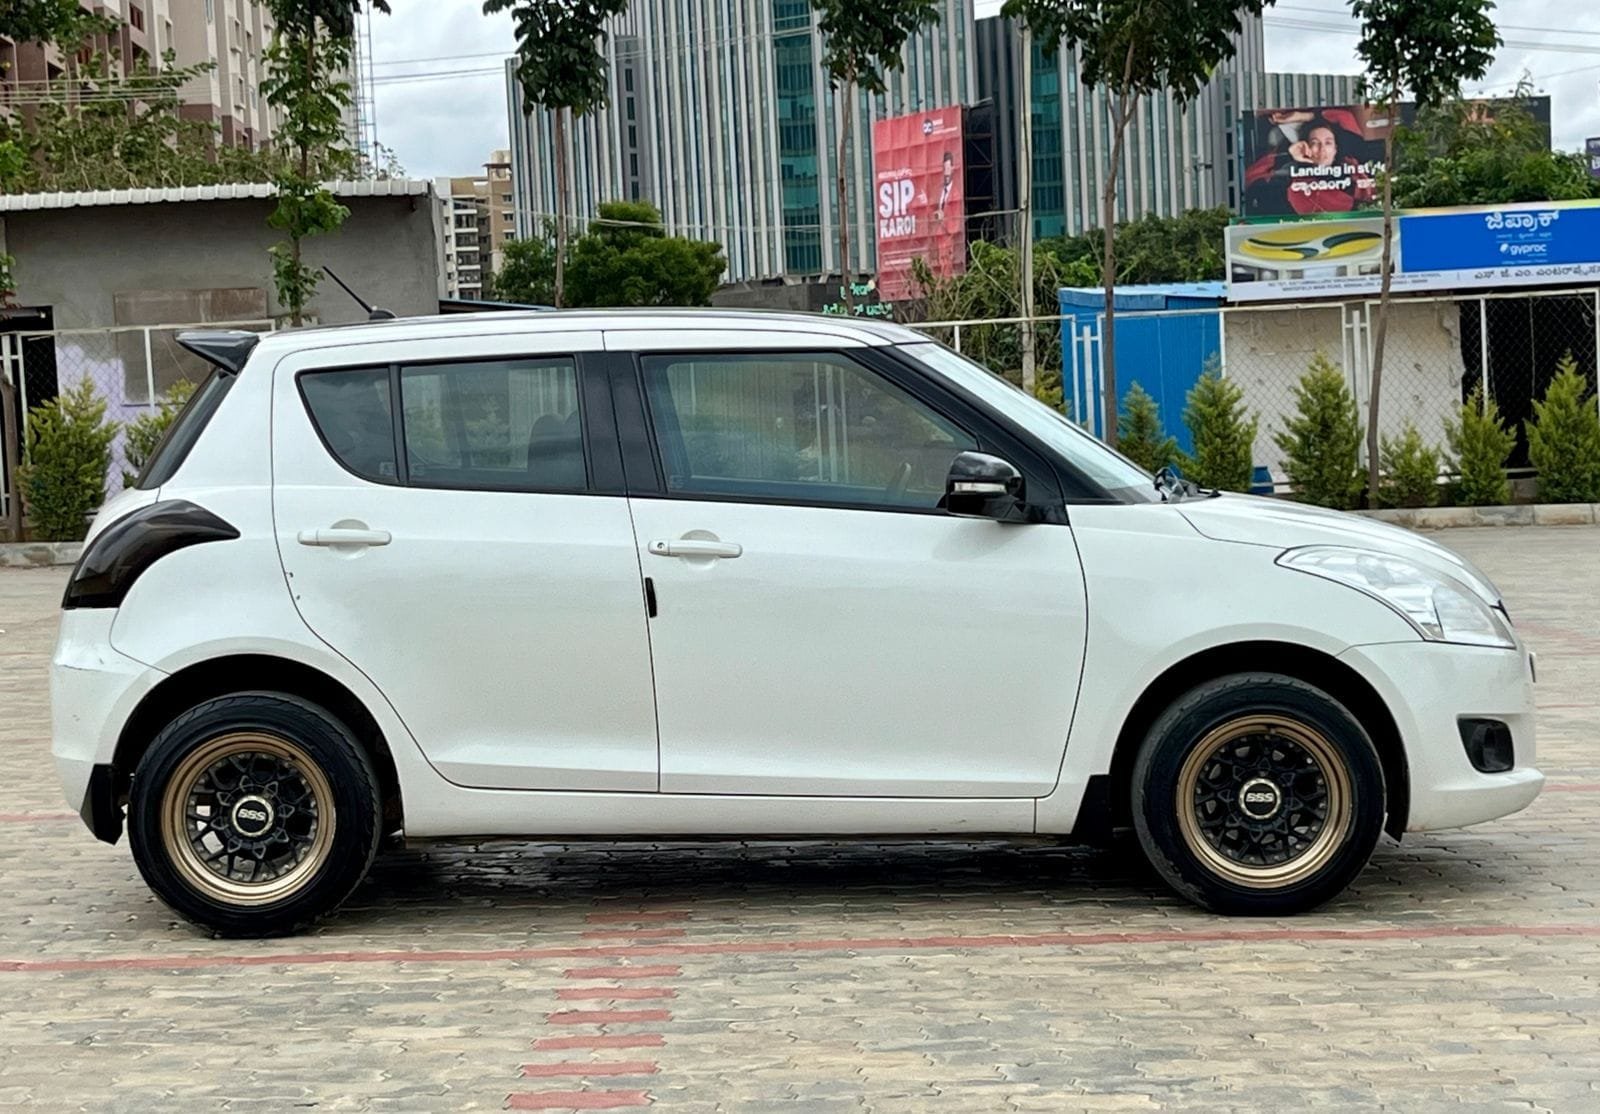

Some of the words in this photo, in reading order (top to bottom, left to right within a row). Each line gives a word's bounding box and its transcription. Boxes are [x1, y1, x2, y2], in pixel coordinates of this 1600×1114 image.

[1290, 164, 1342, 178] Landing
[1343, 162, 1356, 175] in
[879, 179, 915, 219] SIP
[880, 215, 916, 239] KARO!
[1510, 243, 1548, 256] gyproc
